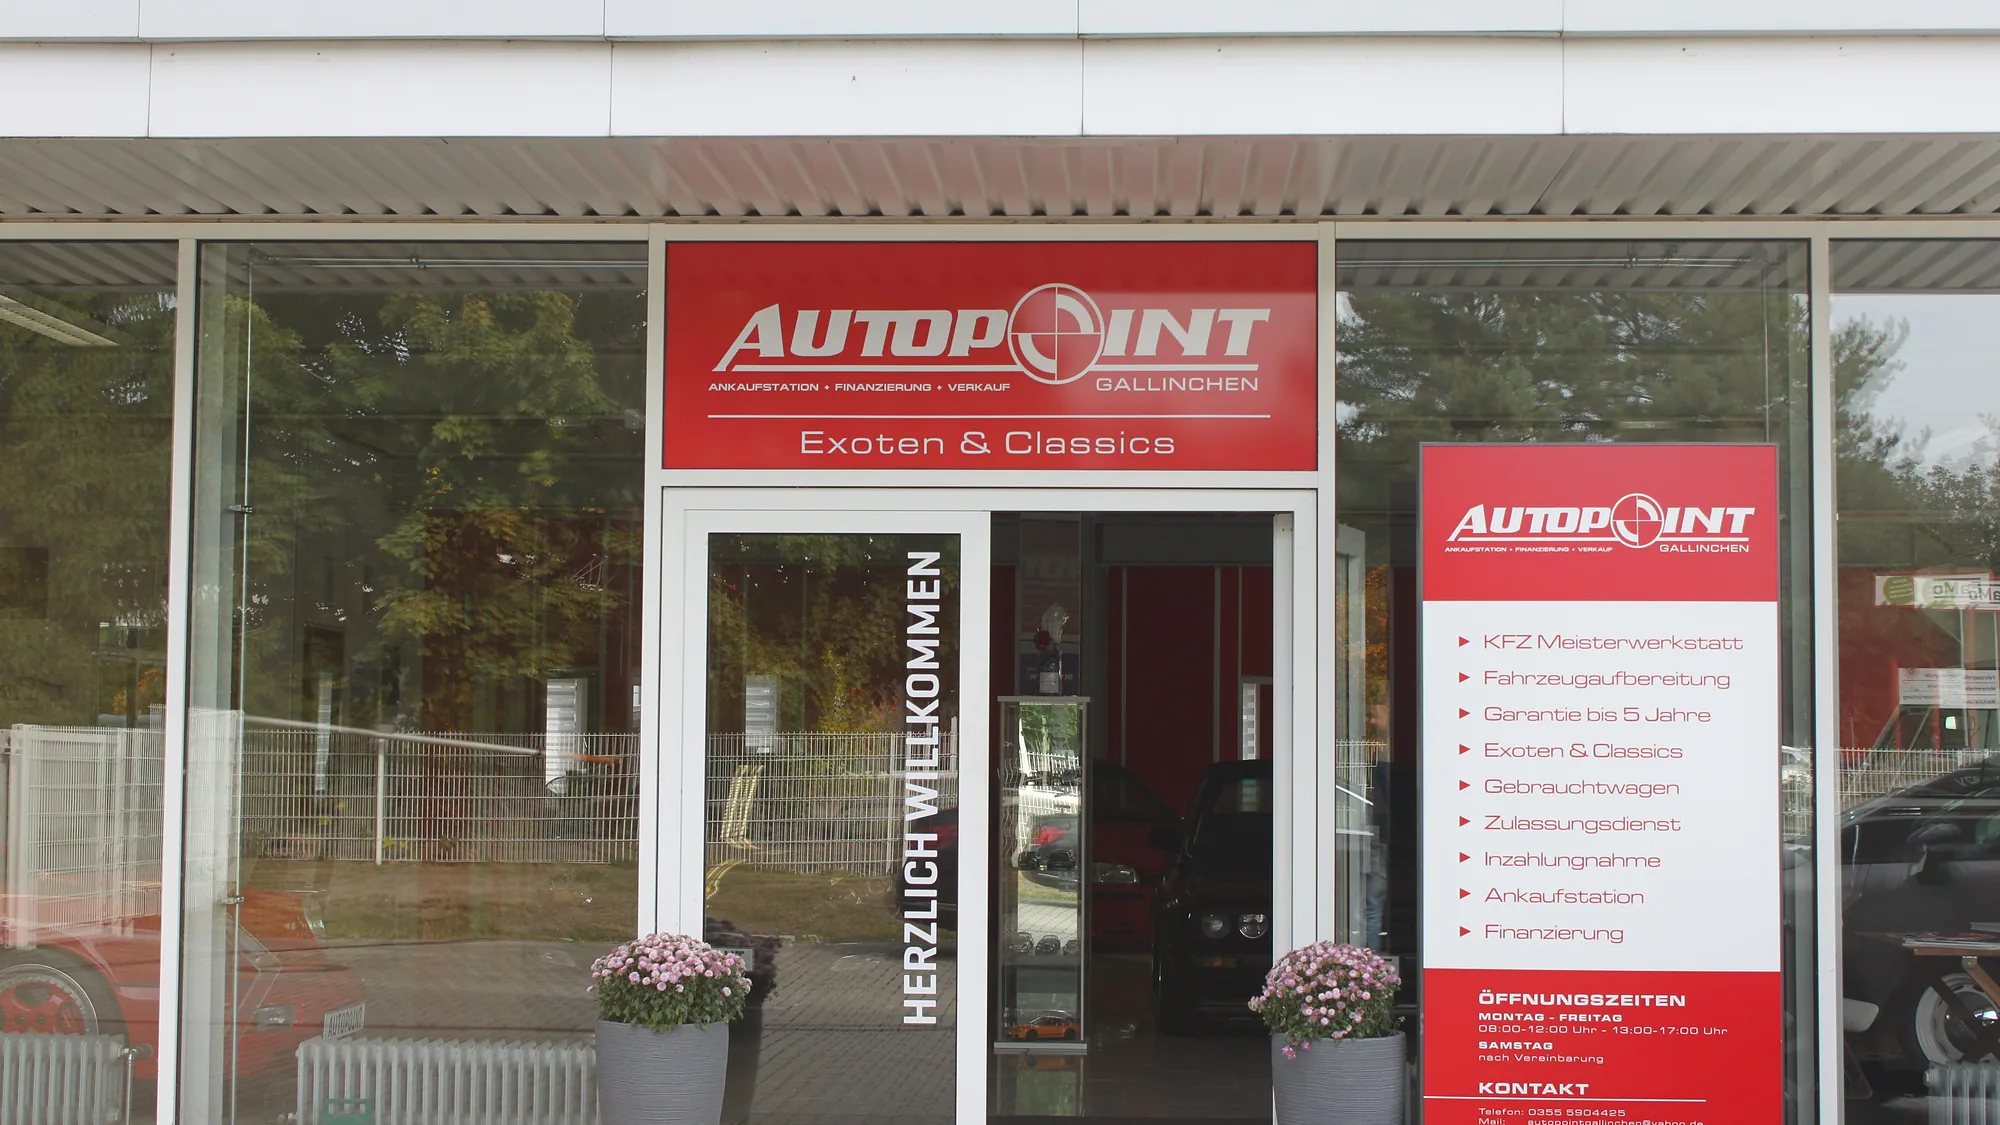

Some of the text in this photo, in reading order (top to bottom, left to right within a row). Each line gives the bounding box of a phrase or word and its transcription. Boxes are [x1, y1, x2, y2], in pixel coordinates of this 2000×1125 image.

[708, 383, 1011, 392] ANKAUFSTATION FINANZIERUNG VERKAUF
[1095, 377, 1259, 392] GALLINCHEN
[802, 431, 1174, 454] Exoten & Classics
[1659, 544, 1750, 553] GALLINCHEN
[1485, 635, 1743, 650] KFZ Meisterwerkstatt
[1485, 671, 1730, 689] Fahrzeugaufbereitung
[1485, 707, 1710, 722] Garantie bis 5 Jahre
[1485, 743, 1682, 758] Exoten & Classics
[903, 551, 941, 1025] HERZLICH WILLKOMMEN
[1485, 779, 1679, 798] Gebrauchtwagen
[1485, 816, 1681, 834] Zulassungsdienst
[1485, 852, 1660, 870] Inzahlungnahme
[1485, 888, 1643, 904] Ankaufstation
[1486, 924, 1623, 943] Finanzierung
[1479, 990, 1685, 1006] ÖFFNUNGSZEITEN
[1478, 1012, 1545, 1022] MONTAG
[1559, 1013, 1623, 1023] FREITAG
[1478, 1024, 1568, 1034] 08:00-12:00
[1572, 1025, 1597, 1034] Uhr
[1612, 1026, 1699, 1035] 13:00-17:00
[1703, 1026, 1728, 1035] Uhr
[1478, 1041, 1553, 1051] SAMSTAG
[1478, 1053, 1604, 1065] nach Vereinbarung
[1478, 1082, 1590, 1096] KONTAKT
[1478, 1107, 1626, 1117] Telefon: 0355 5904425
[1478, 1117, 1506, 1125] Mail:
